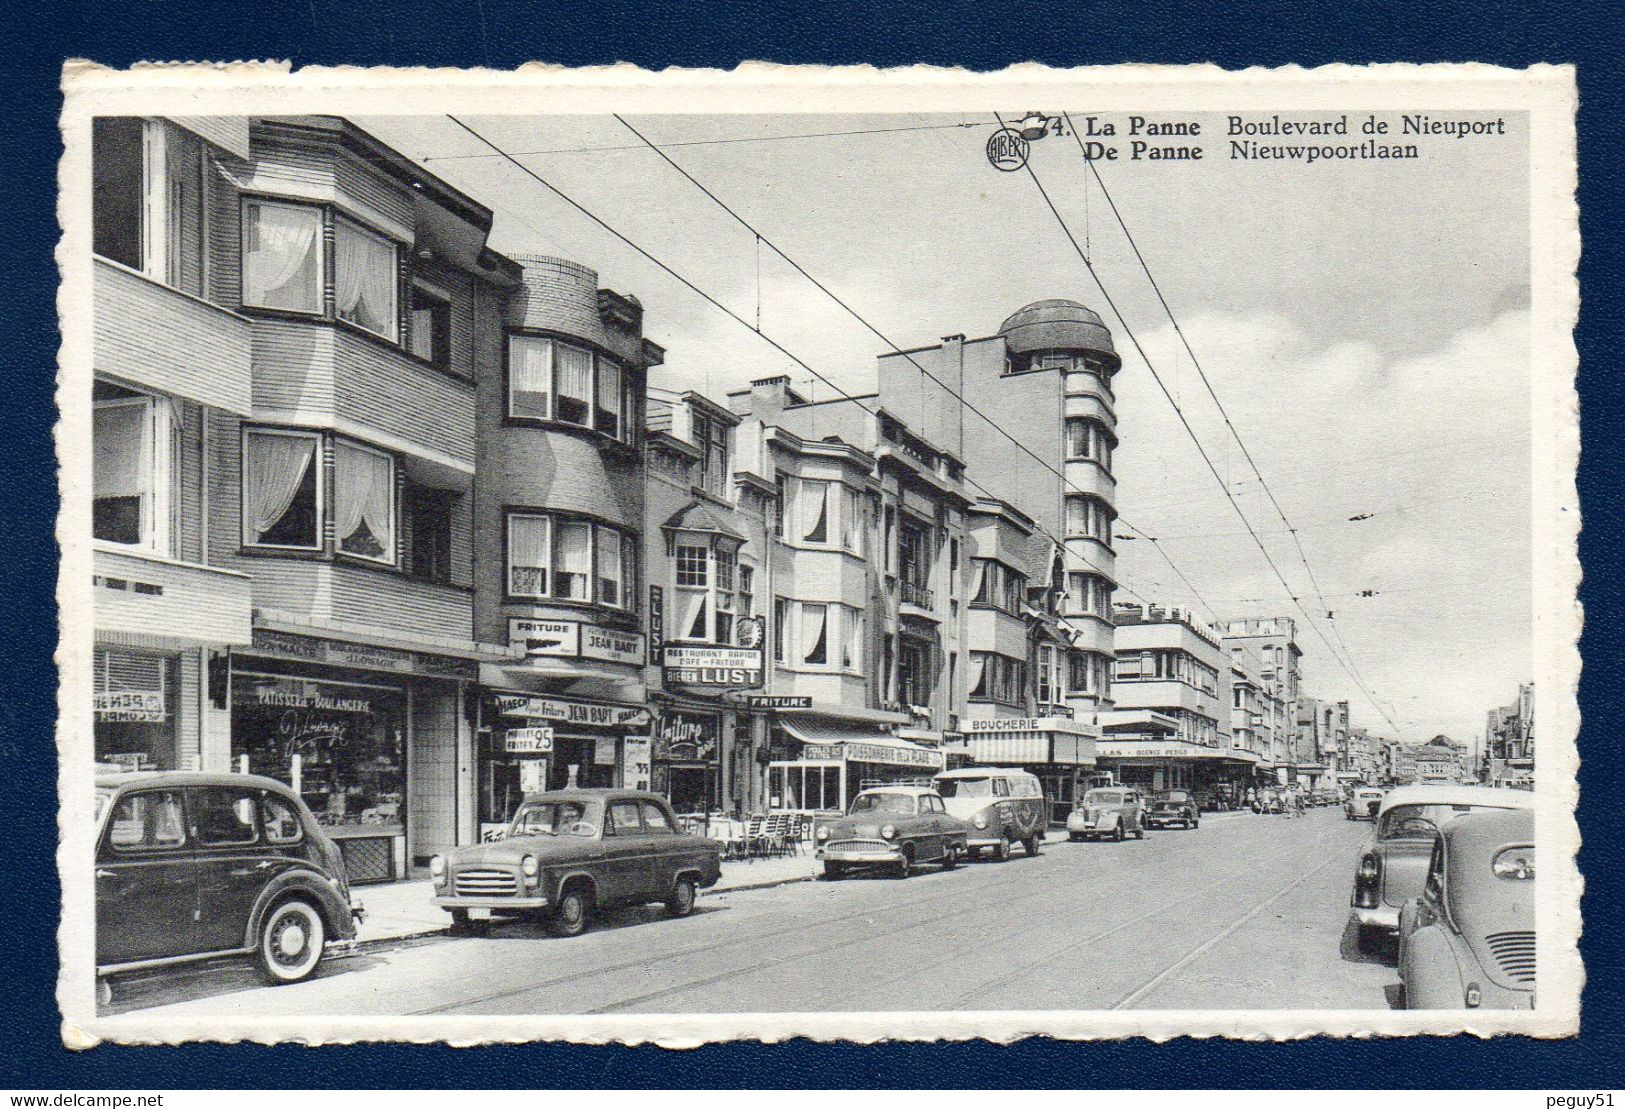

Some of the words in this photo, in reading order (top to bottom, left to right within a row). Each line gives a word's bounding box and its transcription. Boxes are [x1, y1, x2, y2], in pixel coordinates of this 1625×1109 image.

[517, 622, 570, 633] FRITURE
[589, 635, 612, 649] JEAN
[614, 640, 638, 653] BART
[667, 649, 722, 658] RESTAURANT
[728, 650, 758, 659] RAPIDE
[711, 659, 745, 667] FRITURE
[702, 668, 759, 684] LUST
[751, 697, 807, 707] FRITURE
[568, 704, 588, 721] JEAN
[590, 707, 613, 724] BART
[972, 719, 1039, 730] BOUCHERIE
[535, 730, 552, 749] 25
